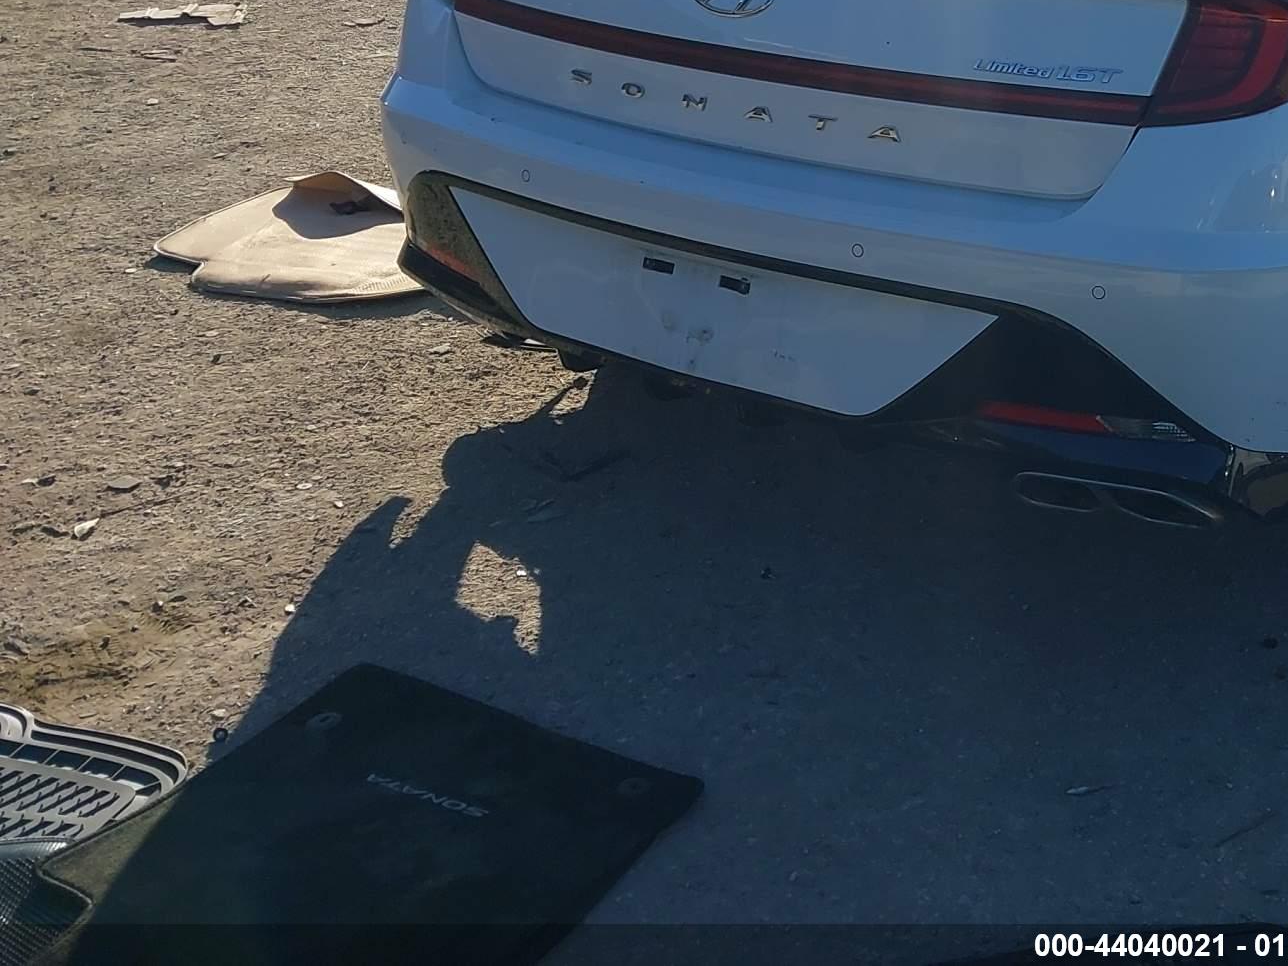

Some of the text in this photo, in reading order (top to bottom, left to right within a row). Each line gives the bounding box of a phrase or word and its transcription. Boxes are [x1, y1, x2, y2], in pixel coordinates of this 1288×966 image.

[973, 58, 1054, 79] Limited
[571, 68, 901, 143] SONATA
[366, 773, 489, 817] SONATA
